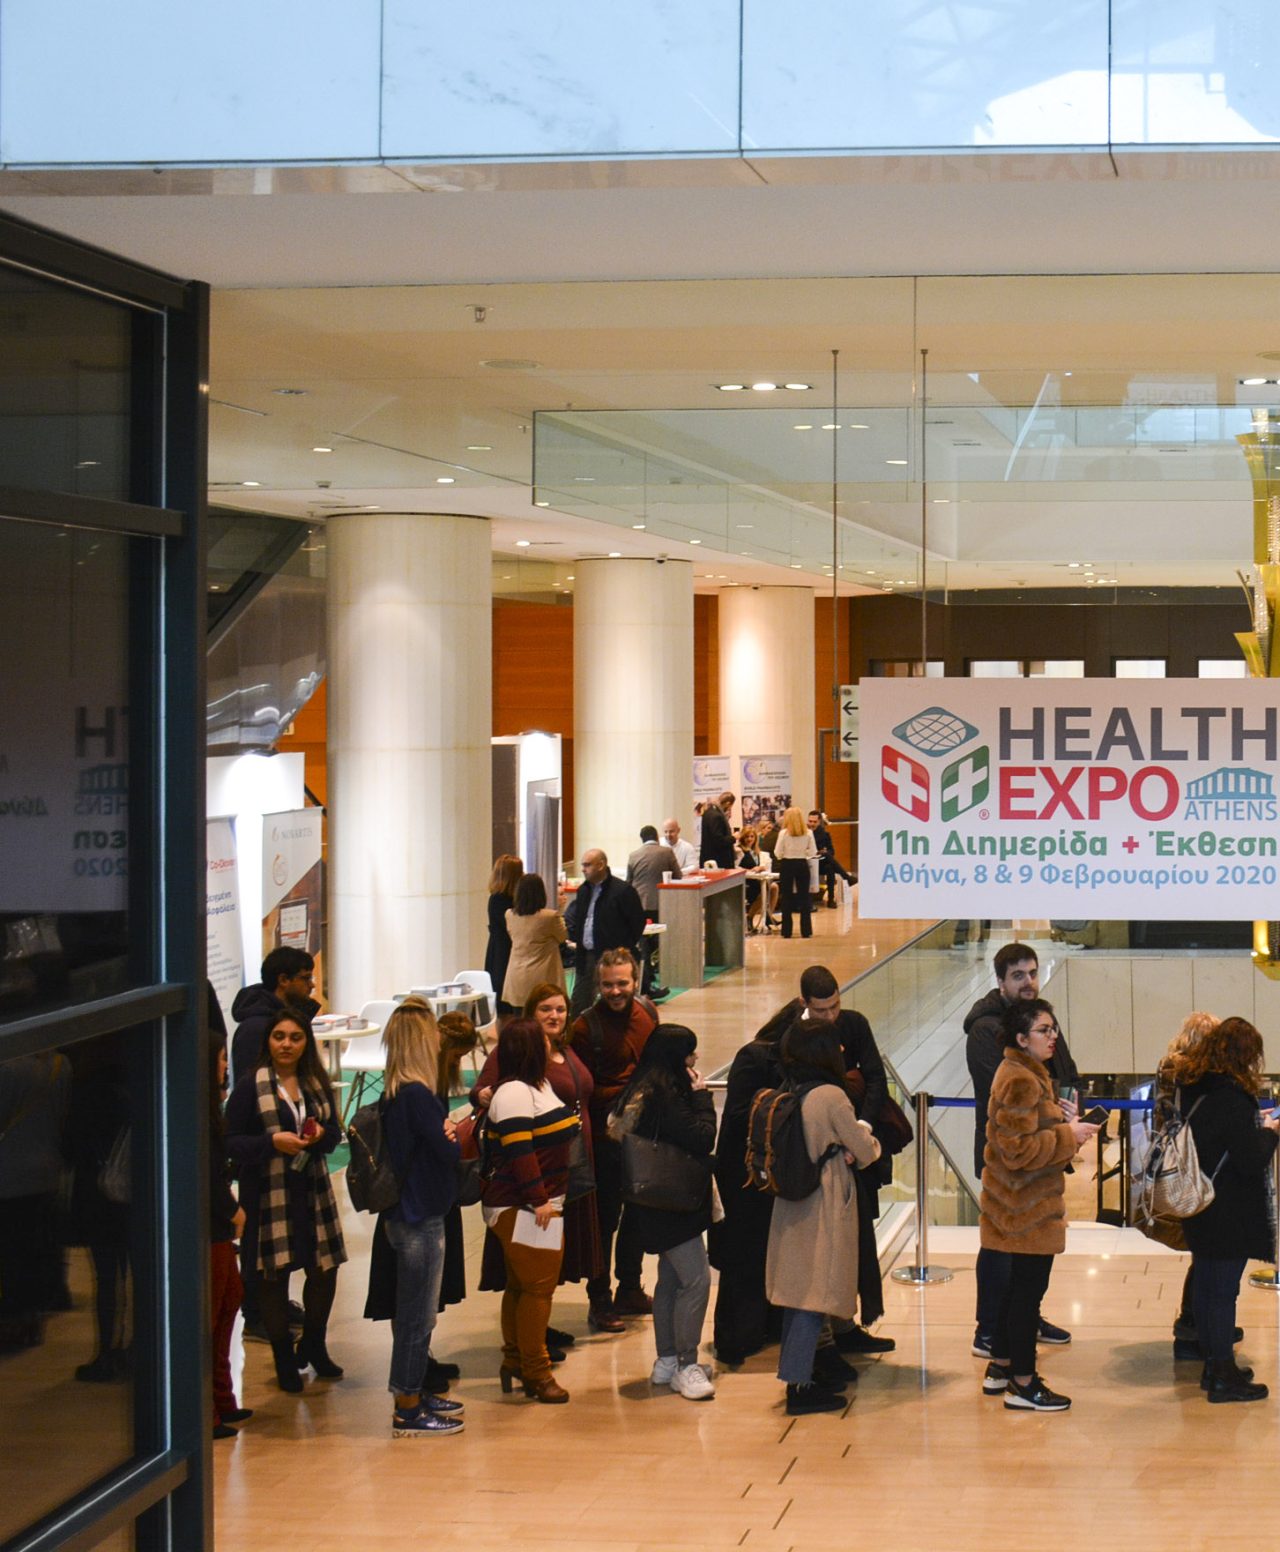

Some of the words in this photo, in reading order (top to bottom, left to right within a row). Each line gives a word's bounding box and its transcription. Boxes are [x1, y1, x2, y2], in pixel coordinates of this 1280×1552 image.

[998, 706, 1278, 761] HEALTH
[998, 766, 1181, 821] EXPO
[1184, 800, 1278, 821] ATHENS
[881, 830, 930, 856] 11η
[942, 829, 1107, 861] Διημερίδα
[1149, 830, 1278, 856] Έκθεση
[881, 862, 967, 889] Αθήνα,
[973, 864, 988, 884] 8
[994, 864, 1013, 884] &
[1019, 864, 1034, 884] 9
[1039, 862, 1209, 890] Φεβρουαρίου
[1216, 865, 1277, 885] 2020
